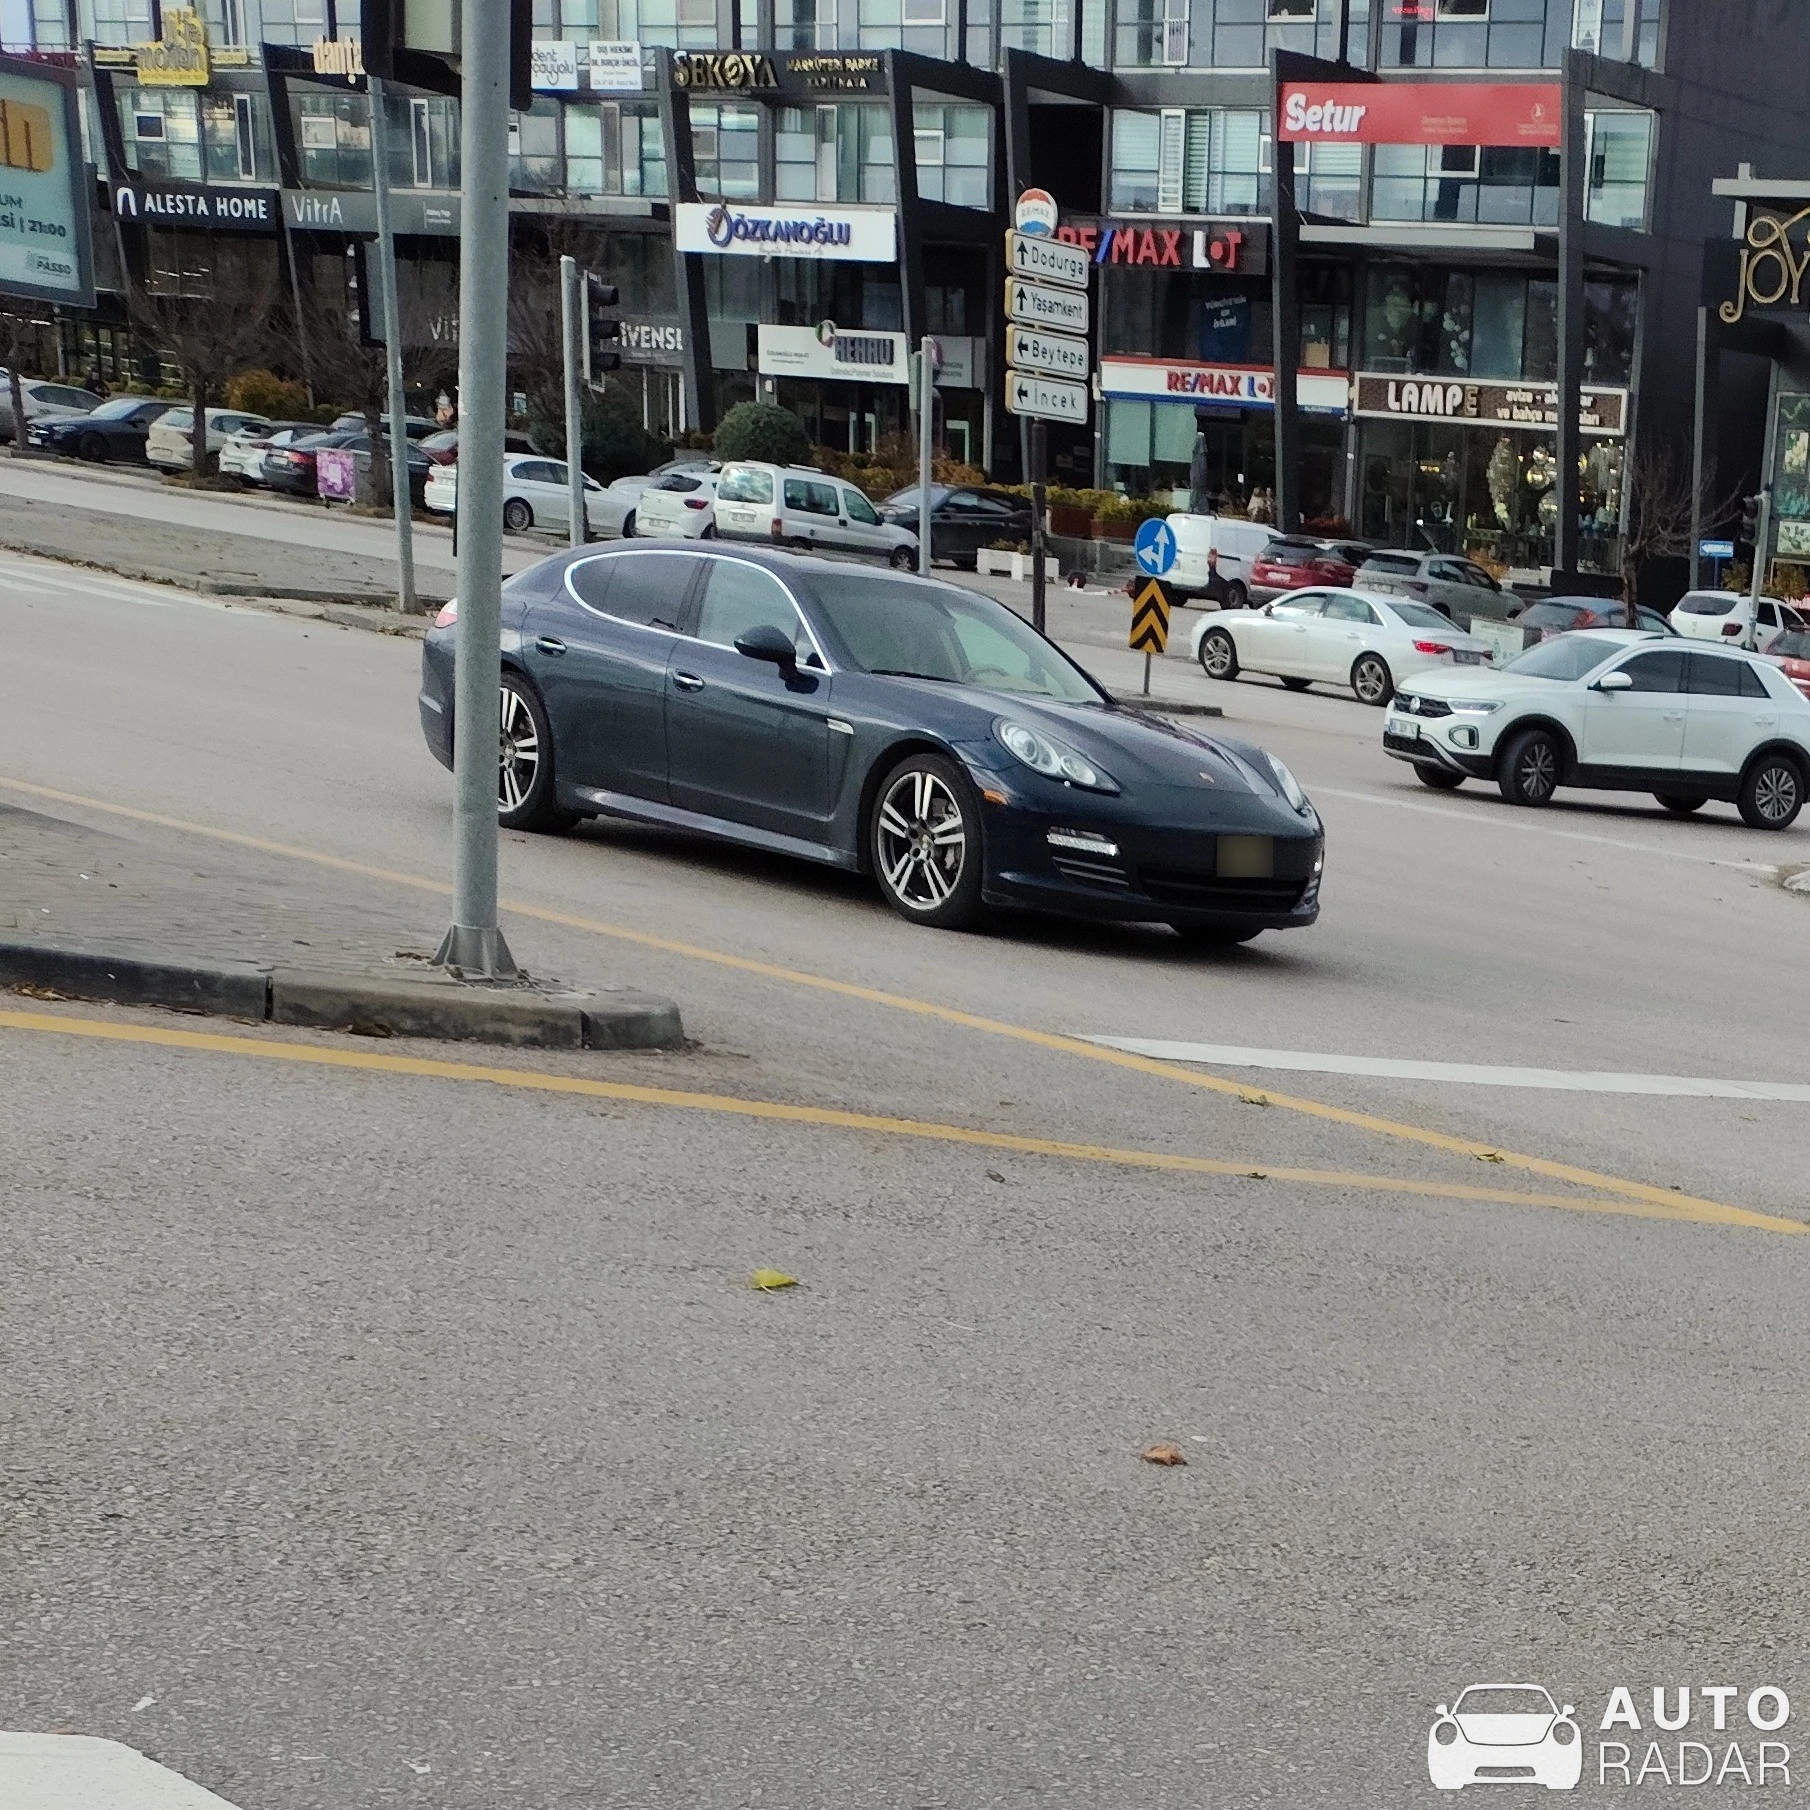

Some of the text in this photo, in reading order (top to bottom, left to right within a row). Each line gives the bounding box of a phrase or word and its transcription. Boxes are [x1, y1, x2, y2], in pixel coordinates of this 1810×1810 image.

[1285, 92, 1366, 132] Setur
[144, 192, 268, 219] ALESTA HOME
[291, 194, 344, 225] VitrA
[733, 212, 851, 246] ÖZKANOĞLU
[1031, 245, 1084, 278] Dodurga
[1030, 291, 1083, 320] Yaşamkent
[1032, 339, 1084, 369] Beytepe
[1166, 370, 1242, 397] RE/MAX
[1387, 381, 1479, 417] LAMPE
